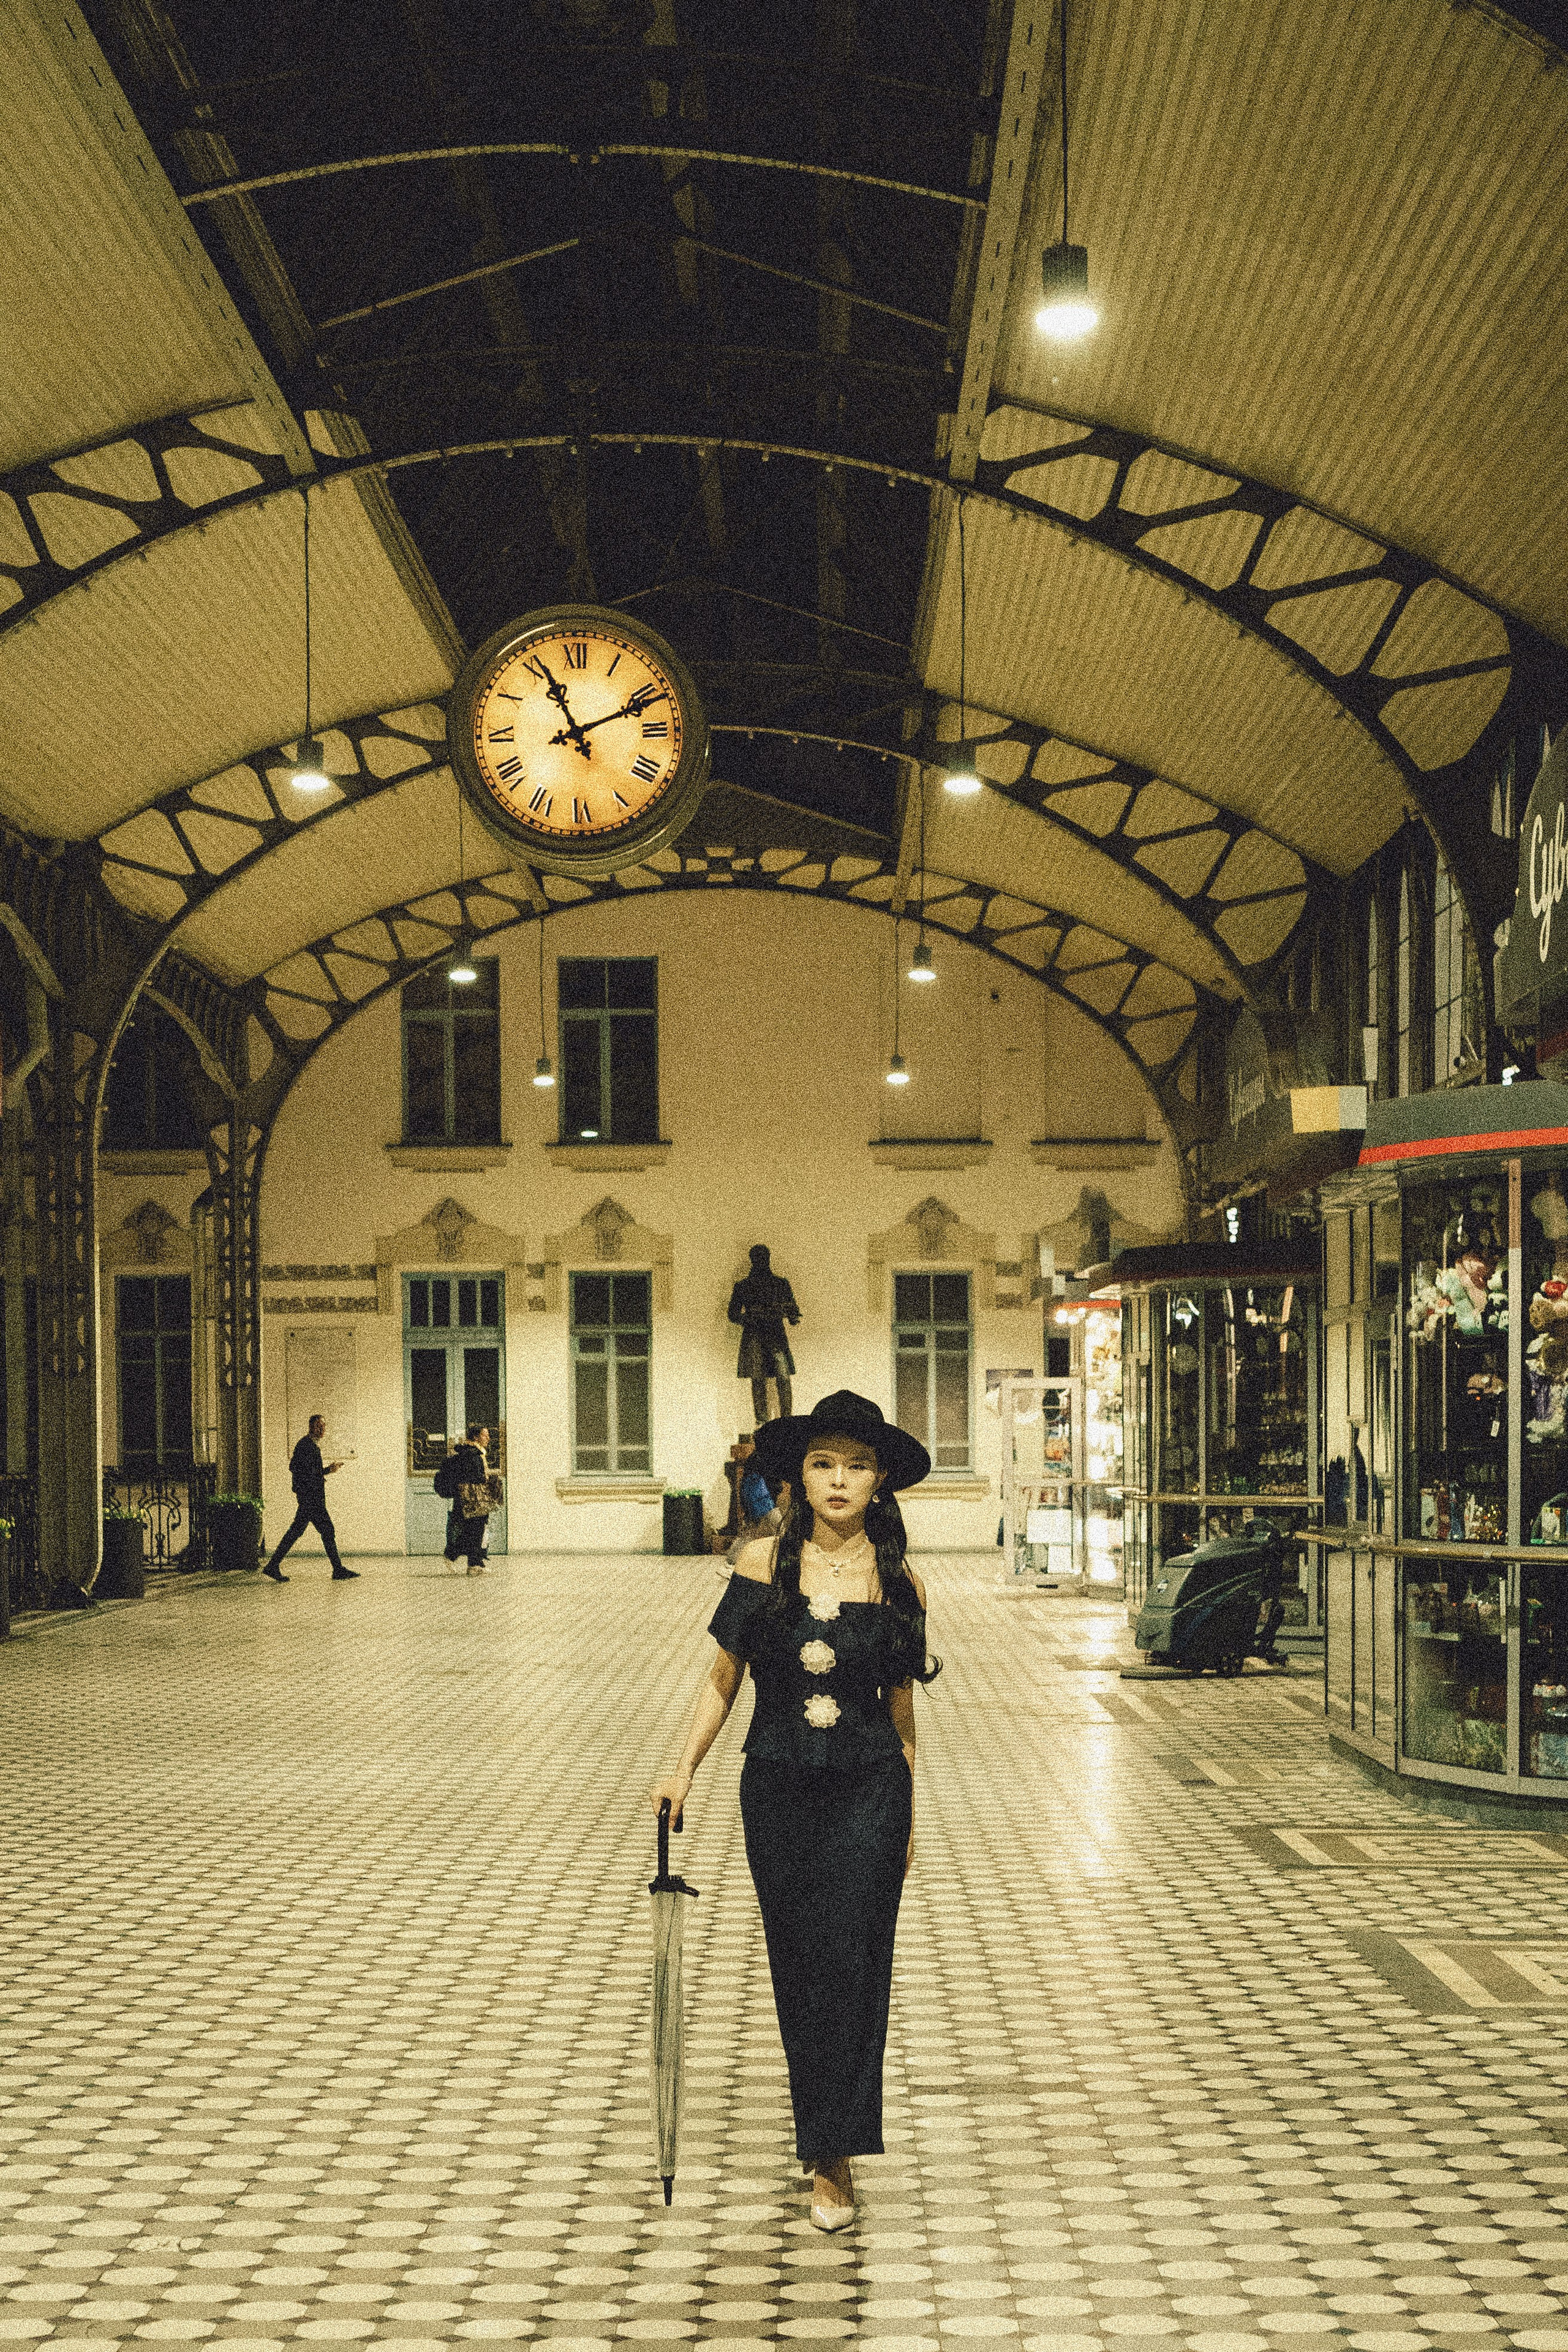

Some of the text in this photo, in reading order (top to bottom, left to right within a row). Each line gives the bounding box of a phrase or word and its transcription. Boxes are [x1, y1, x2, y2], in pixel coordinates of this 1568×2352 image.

[564, 644, 587, 669] XII
[607, 654, 621, 677] I
[497, 686, 524, 709] X
[488, 725, 514, 743] IX
[643, 722, 668, 737] III
[496, 756, 526, 792] VIII
[631, 754, 660, 783] IIII
[529, 786, 554, 817] VII
[574, 798, 592, 823] VI
[614, 790, 630, 812] V
